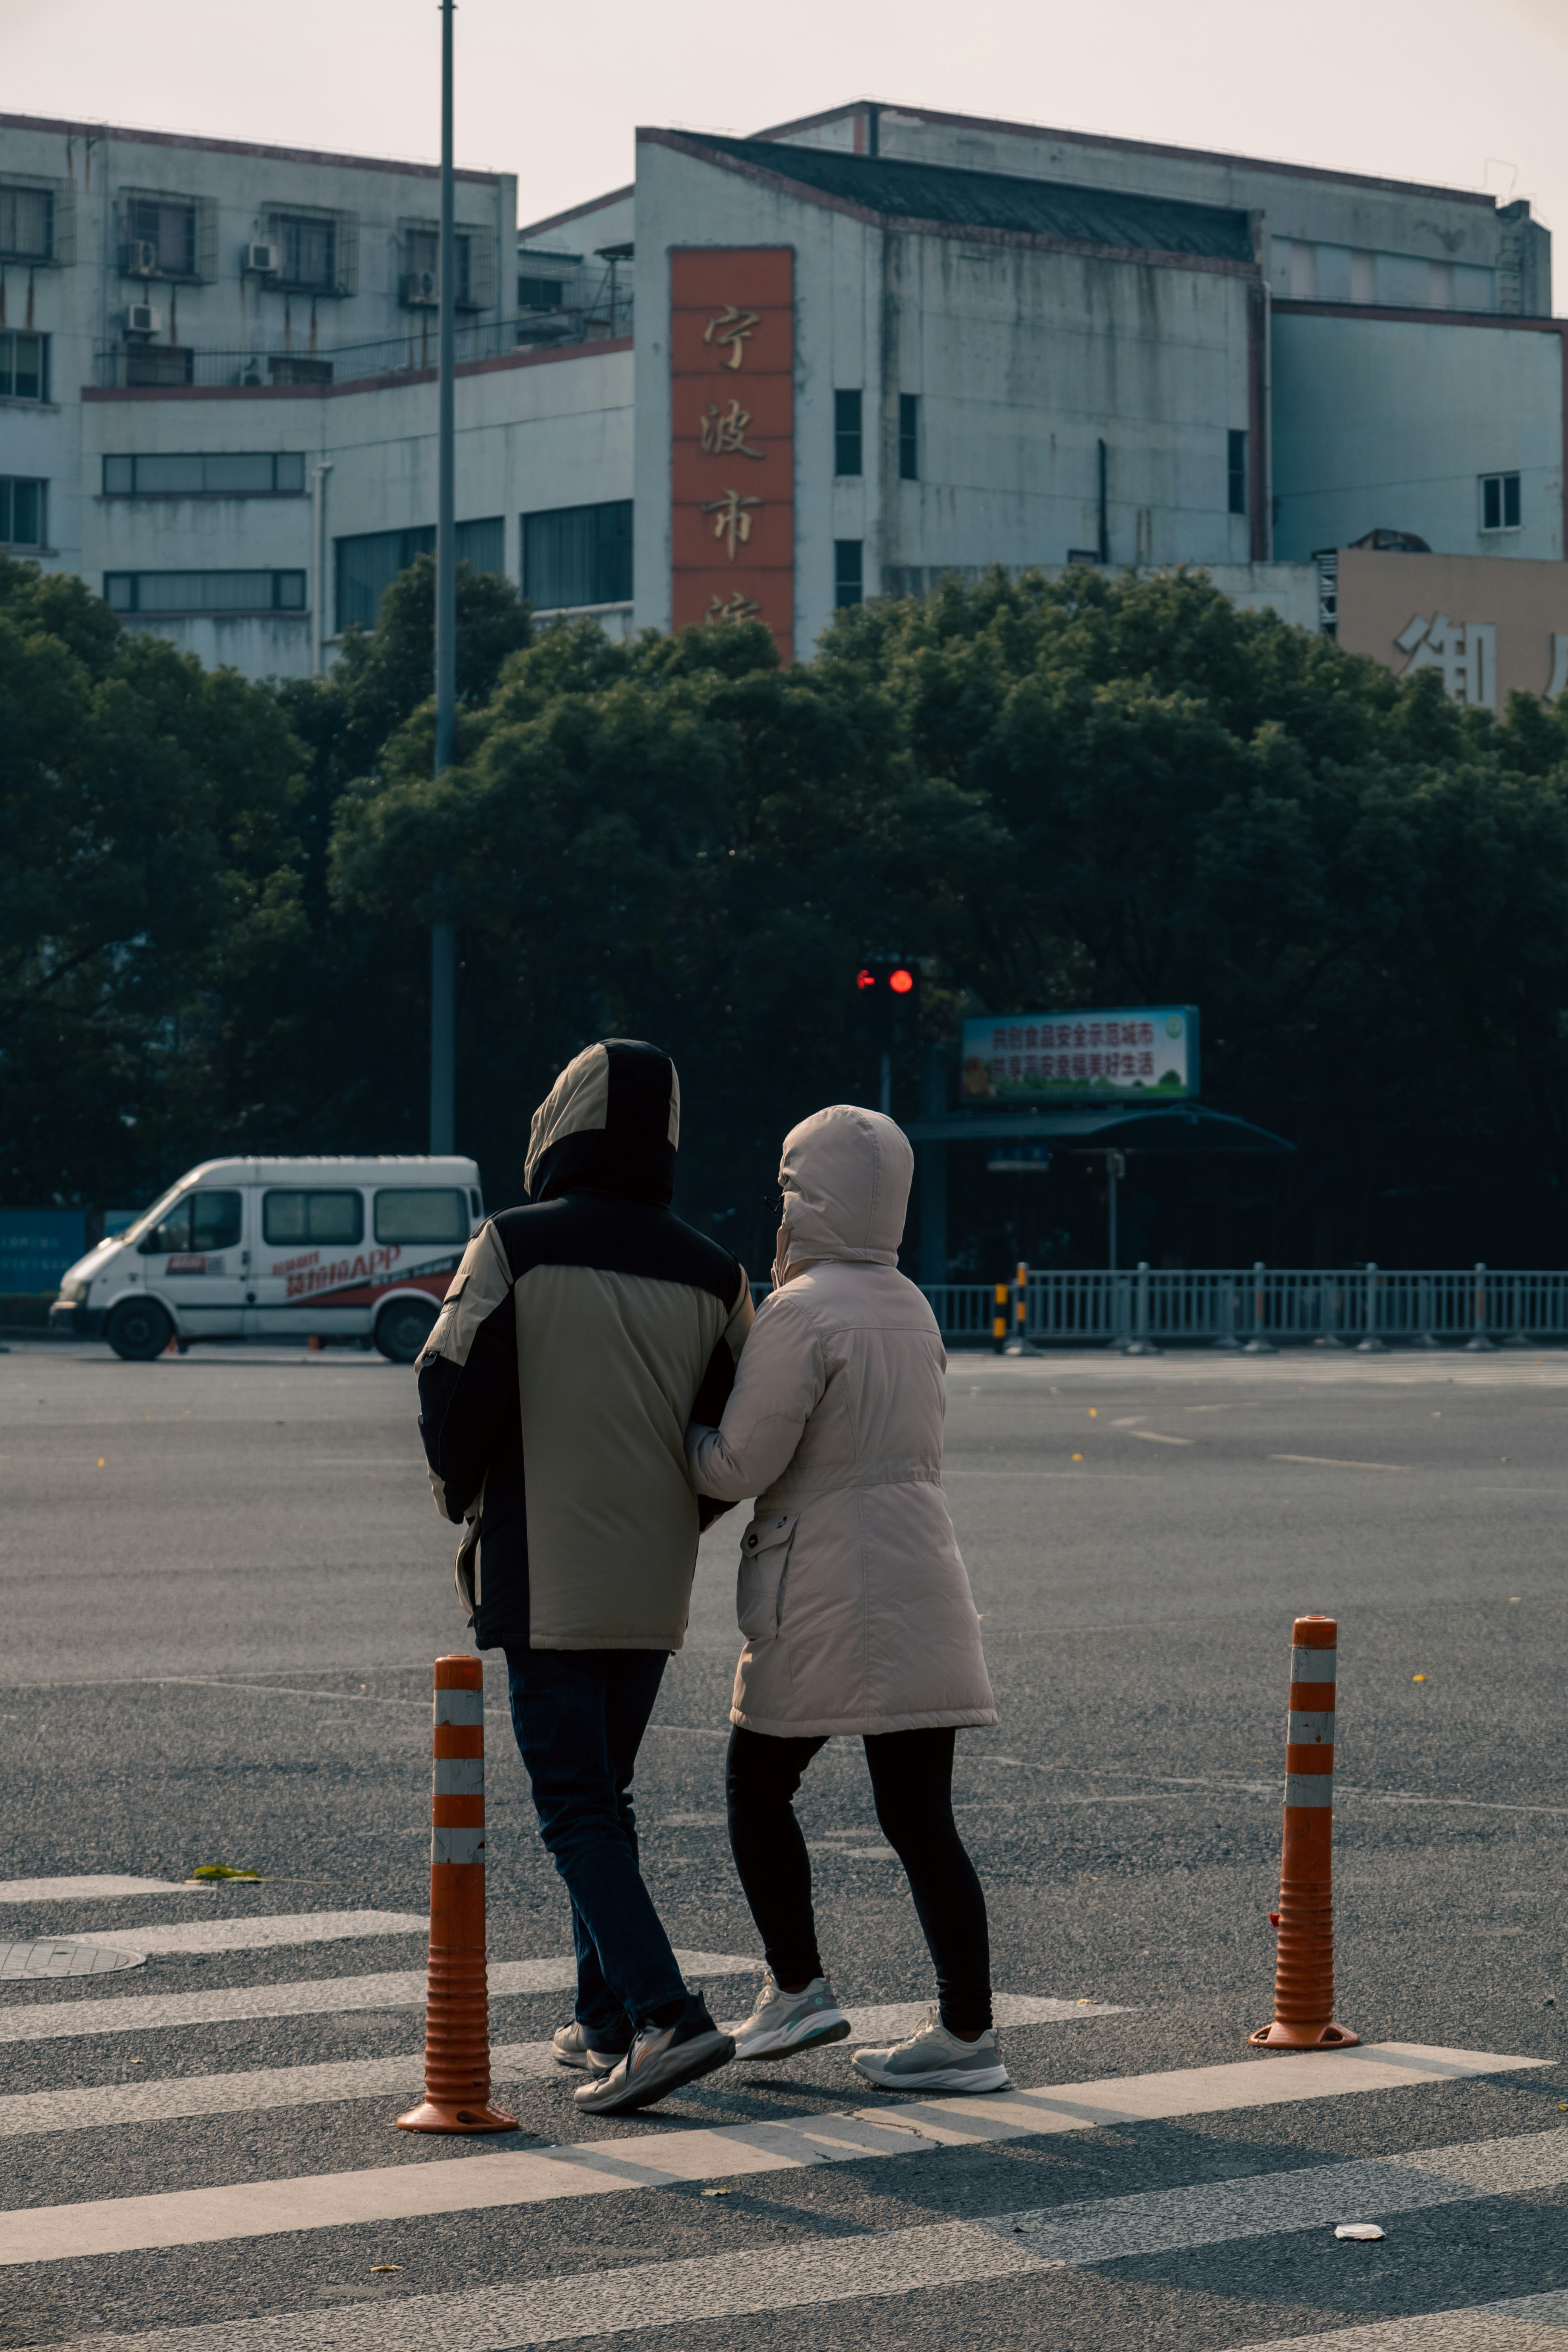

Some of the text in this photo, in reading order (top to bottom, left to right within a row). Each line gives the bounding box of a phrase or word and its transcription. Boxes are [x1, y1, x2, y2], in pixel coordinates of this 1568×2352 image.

[1395, 611, 1568, 708] 御
[992, 1021, 1154, 1050] 共创食品安全示范城市
